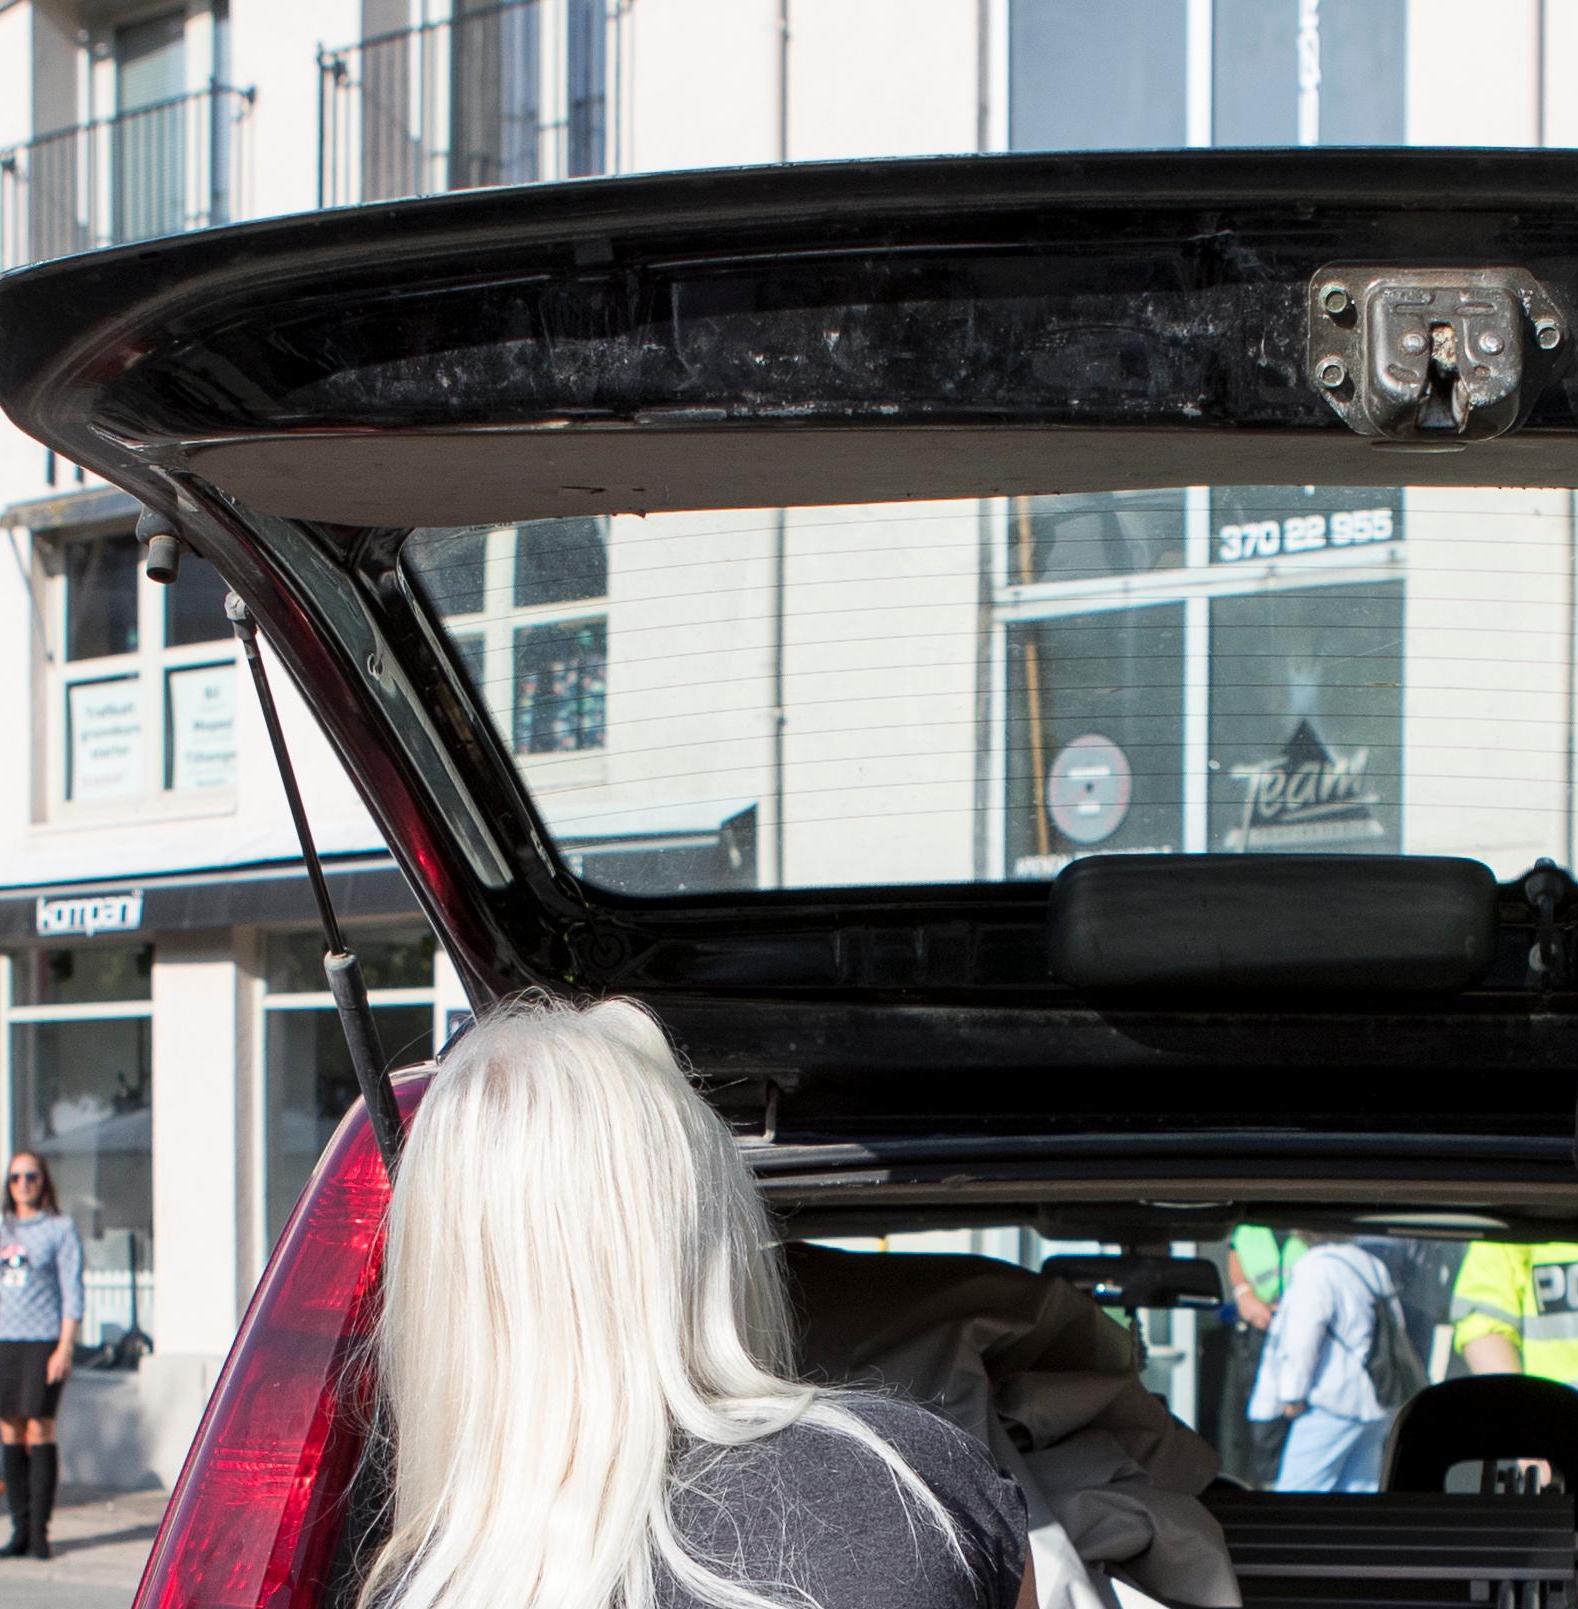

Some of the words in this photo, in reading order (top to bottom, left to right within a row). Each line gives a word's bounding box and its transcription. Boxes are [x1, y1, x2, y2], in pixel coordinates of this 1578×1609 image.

[1219, 519, 1281, 562] 370
[1283, 514, 1327, 552] 22
[1331, 506, 1393, 547] 955
[1229, 748, 1370, 852] Team
[36, 887, 142, 938] kompani
